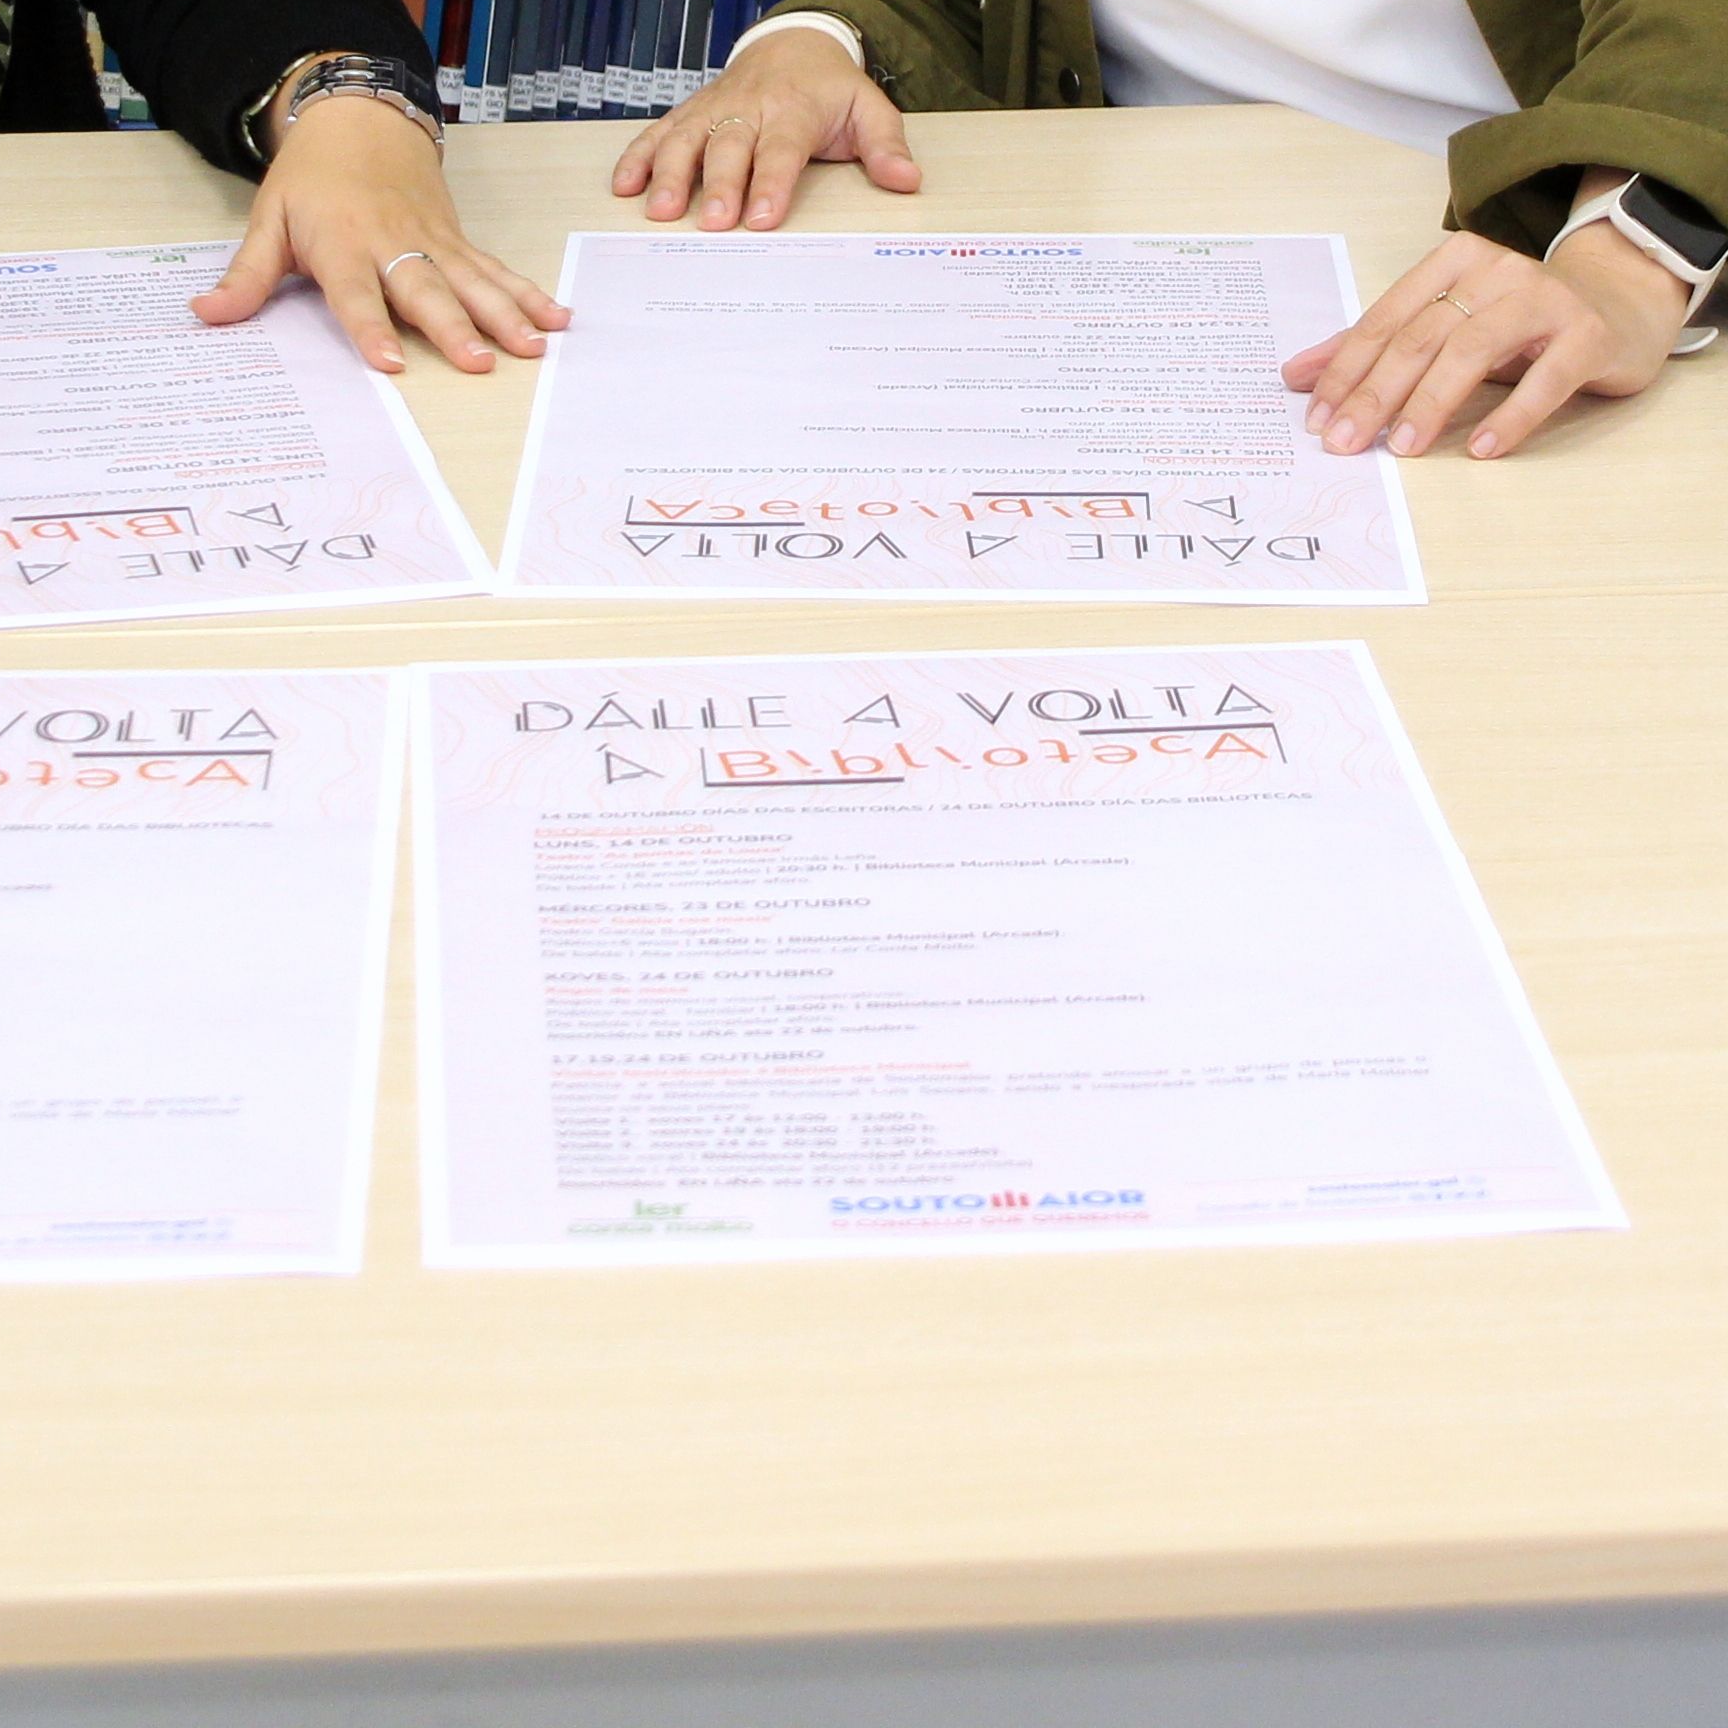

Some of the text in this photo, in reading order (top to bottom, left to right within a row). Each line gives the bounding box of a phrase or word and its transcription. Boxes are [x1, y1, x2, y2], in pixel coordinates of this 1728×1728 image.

[125, 533, 376, 579] DÁLLE
[620, 529, 1324, 568] DÁLLE A VOLTA
[16, 560, 72, 586] A
[514, 682, 1276, 734] DÁLLE A VOLTA
[605, 742, 667, 786] Á
